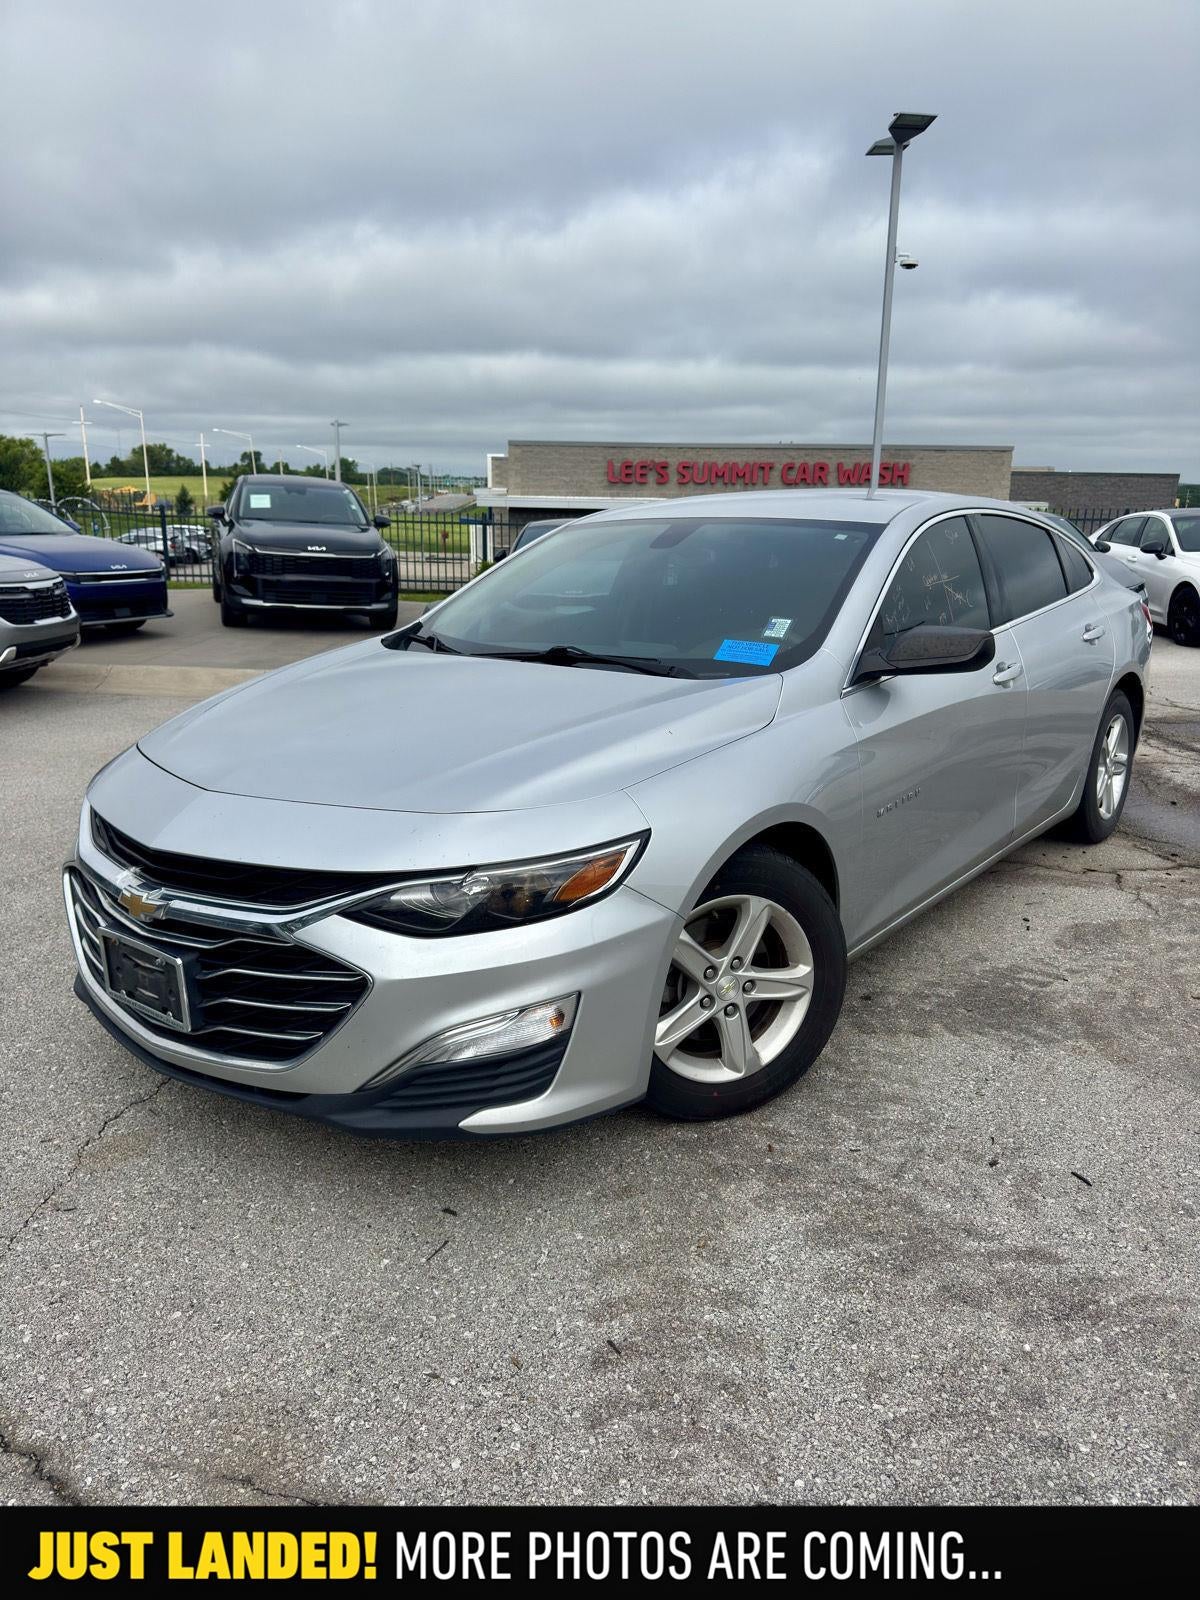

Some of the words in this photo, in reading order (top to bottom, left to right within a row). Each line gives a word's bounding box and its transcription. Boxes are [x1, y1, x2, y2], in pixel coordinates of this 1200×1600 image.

[607, 460, 670, 484] LEE'S
[676, 462, 774, 485] SUMMIT
[781, 462, 829, 485] CAR
[837, 462, 910, 485] WASH
